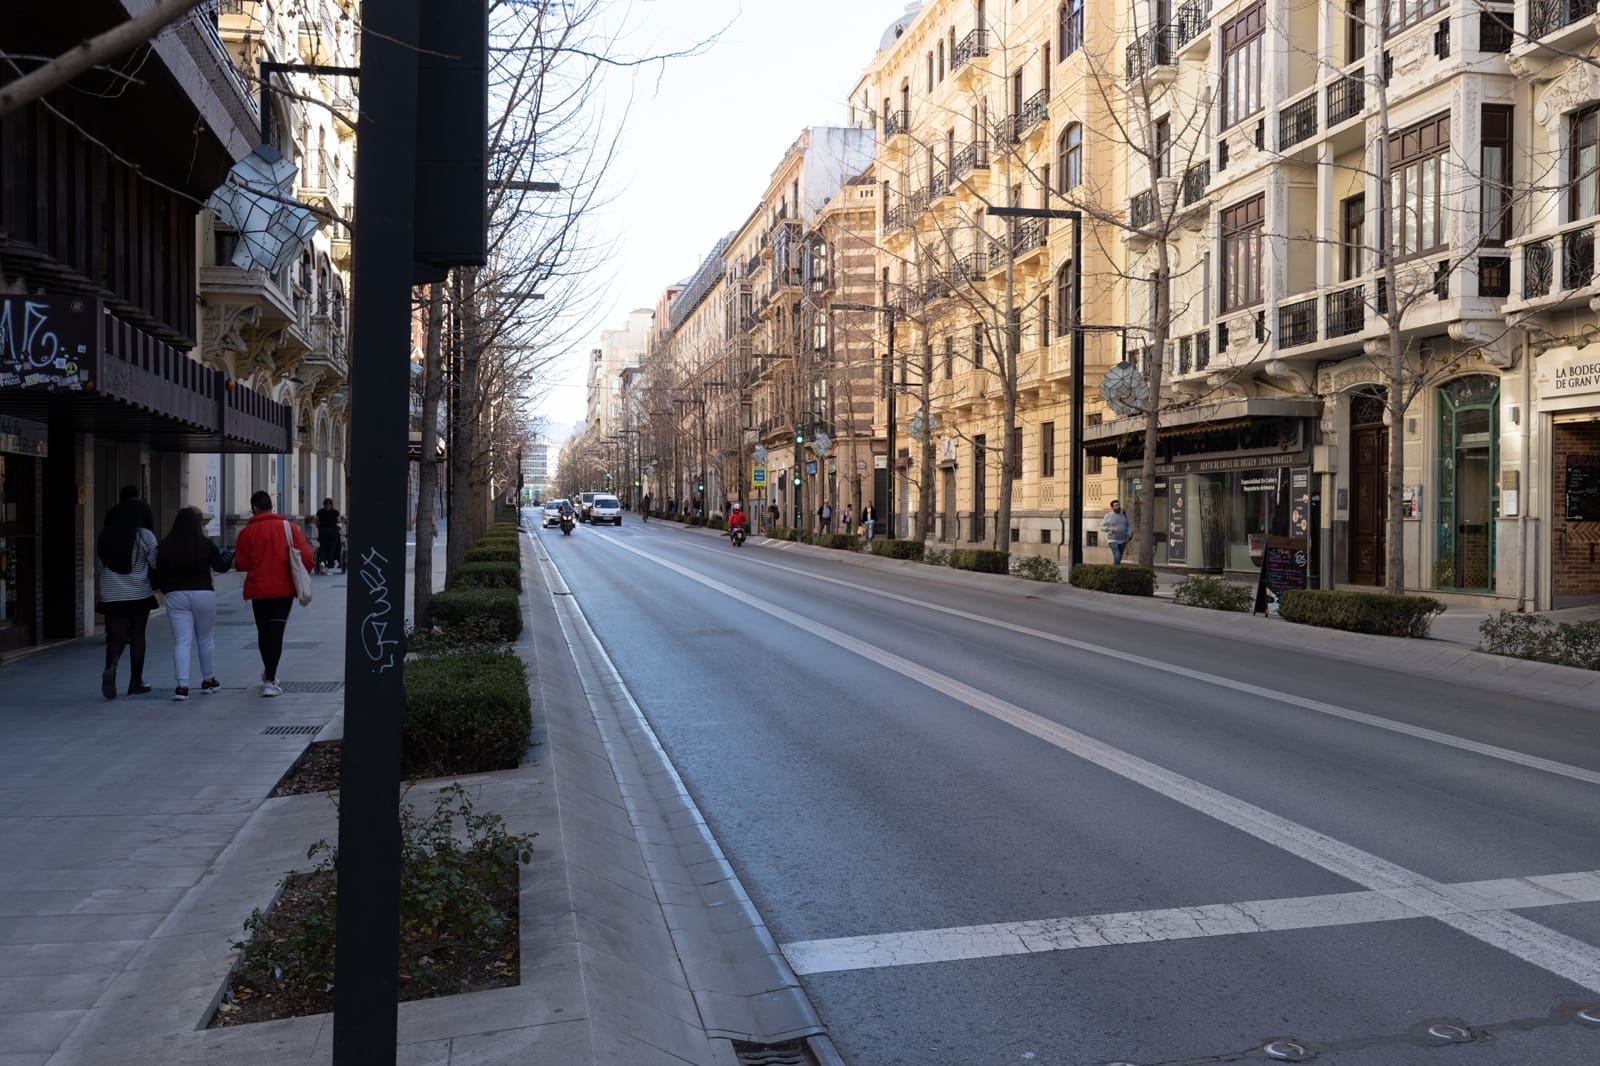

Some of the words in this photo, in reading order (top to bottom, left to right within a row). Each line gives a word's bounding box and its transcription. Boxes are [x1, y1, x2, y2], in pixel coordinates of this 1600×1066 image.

[1556, 368, 1566, 378] LA
[1556, 379, 1566, 389] DE
[1568, 376, 1591, 388] GRAN
